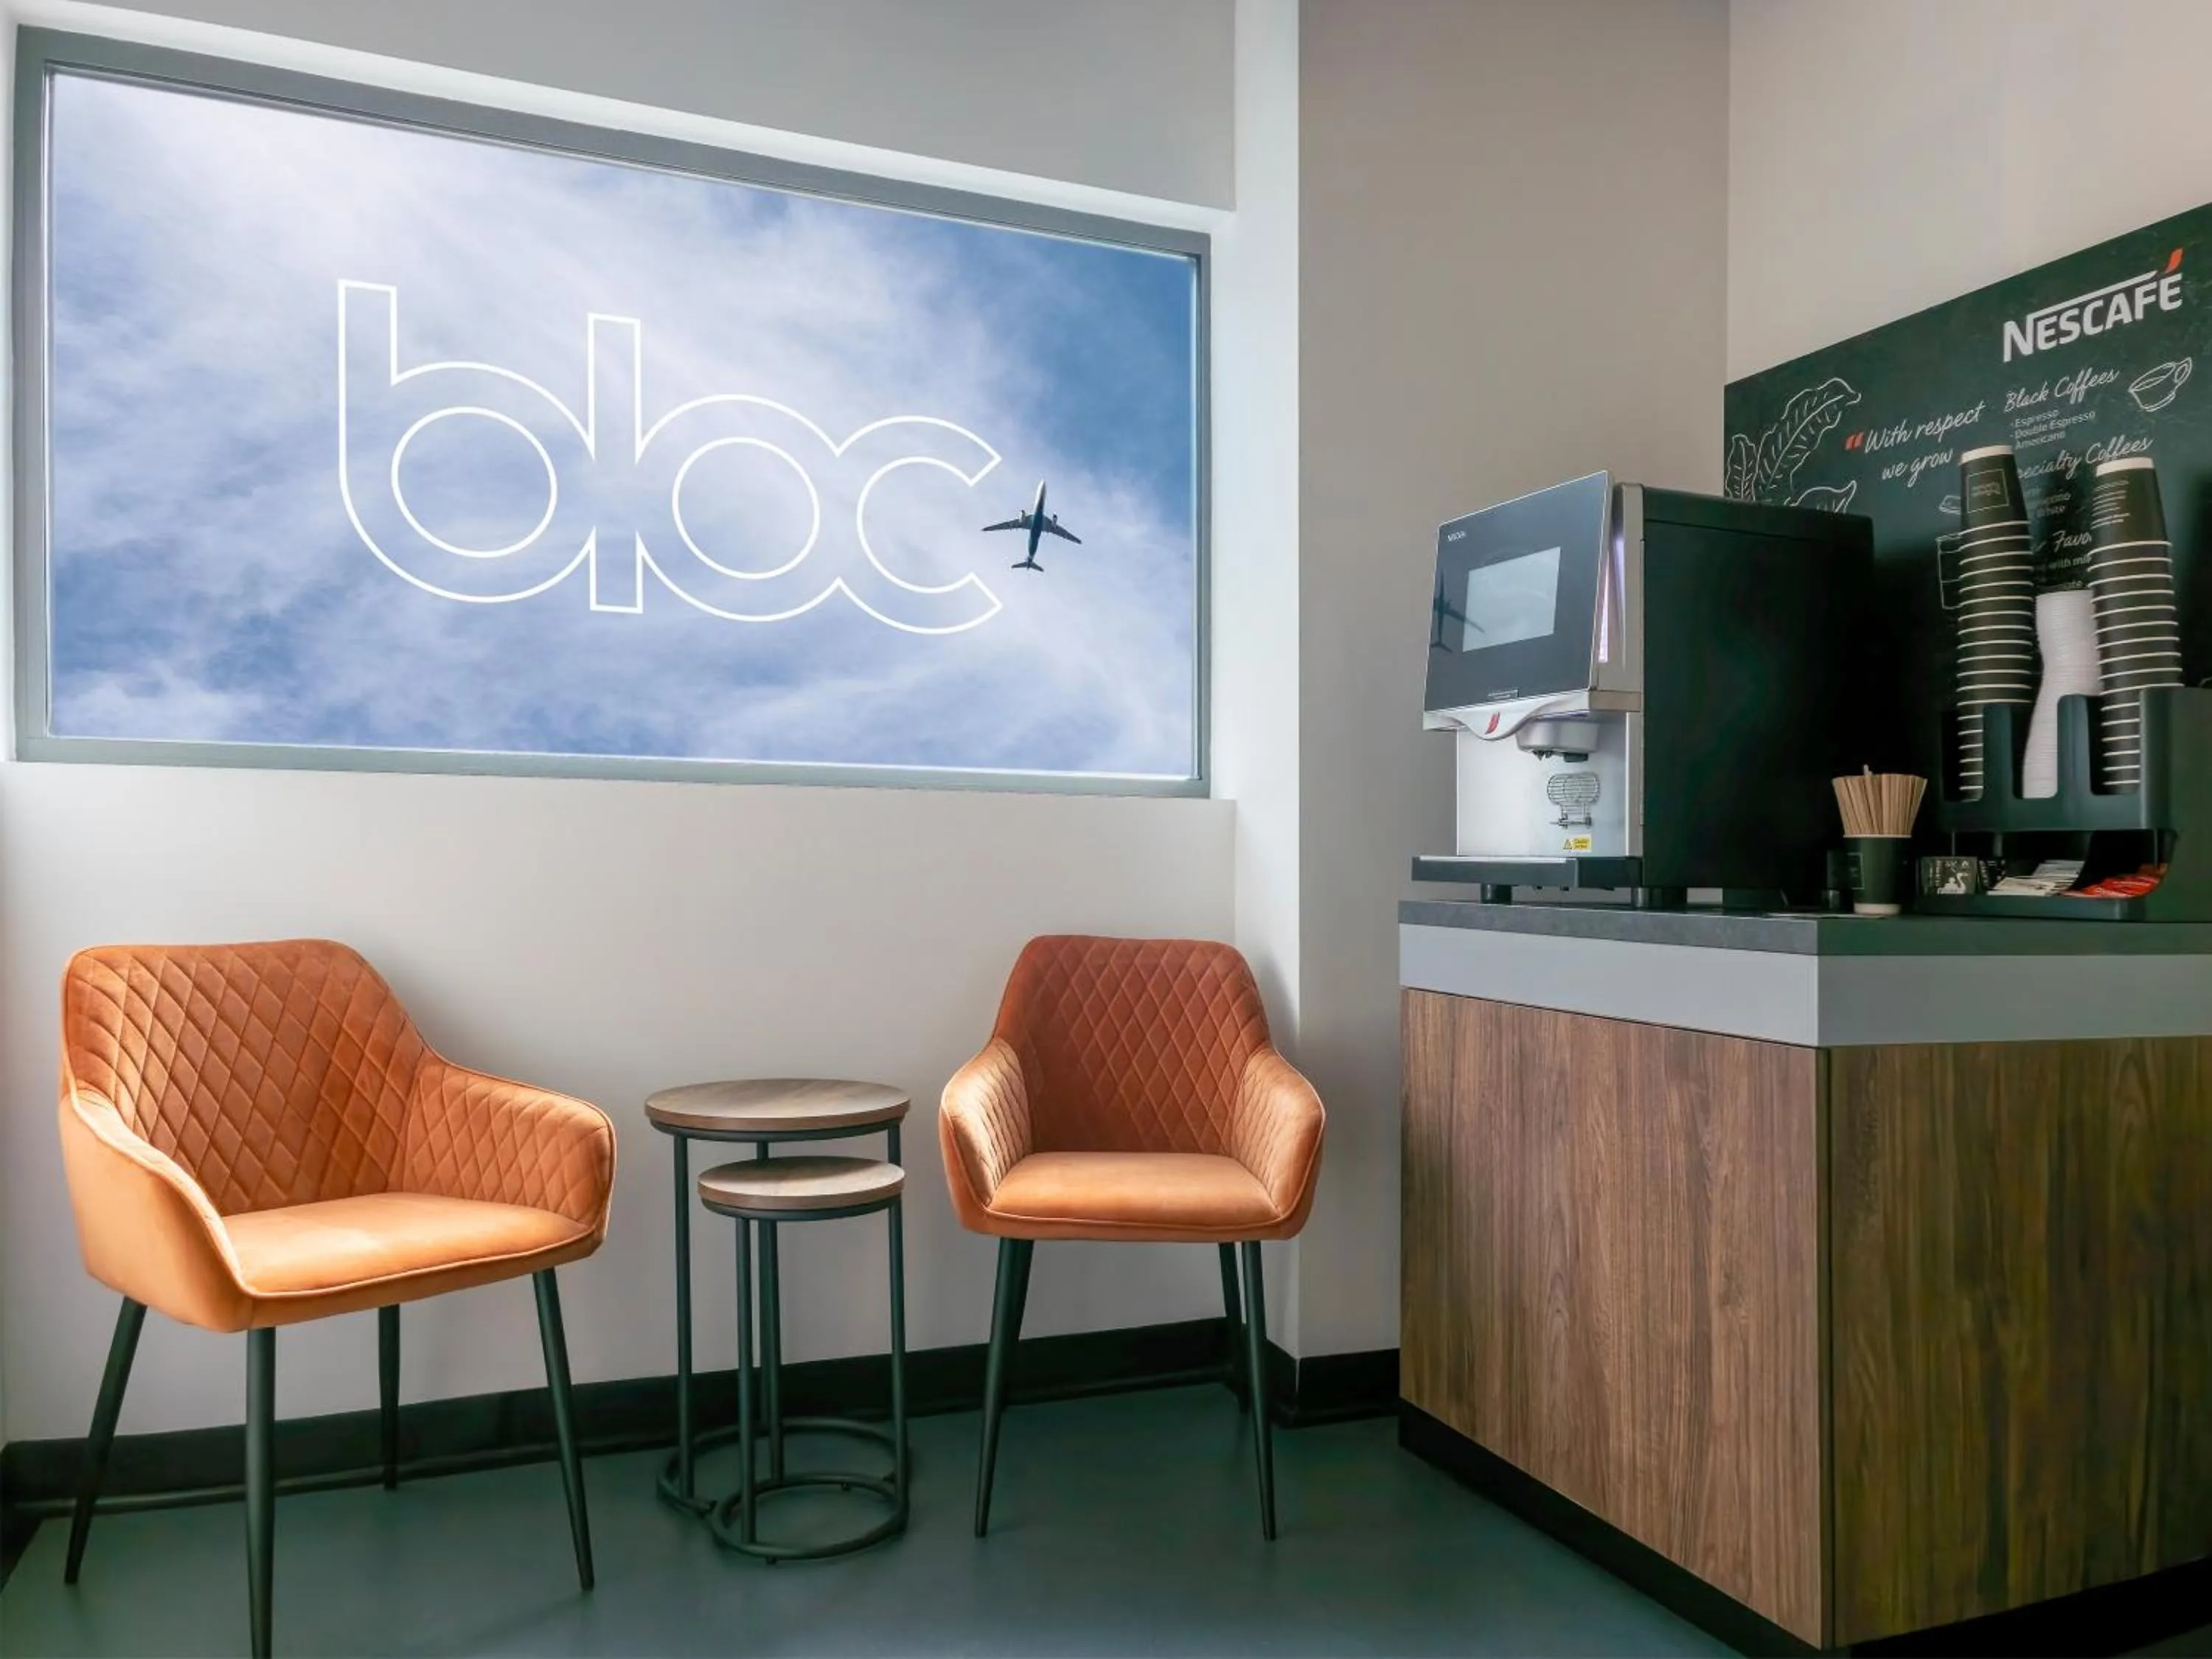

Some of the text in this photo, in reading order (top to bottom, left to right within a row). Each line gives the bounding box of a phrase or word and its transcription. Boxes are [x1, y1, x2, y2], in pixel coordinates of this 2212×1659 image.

[2003, 248, 2183, 363] NESCAFÉ
[2004, 368, 2121, 413] Black Coffees
[1914, 400, 1986, 443] respect
[2049, 411, 2096, 430] Espresso
[338, 278, 1003, 636] bloc
[1882, 448, 1953, 488] we grow
[2085, 434, 2153, 465] Coffees
